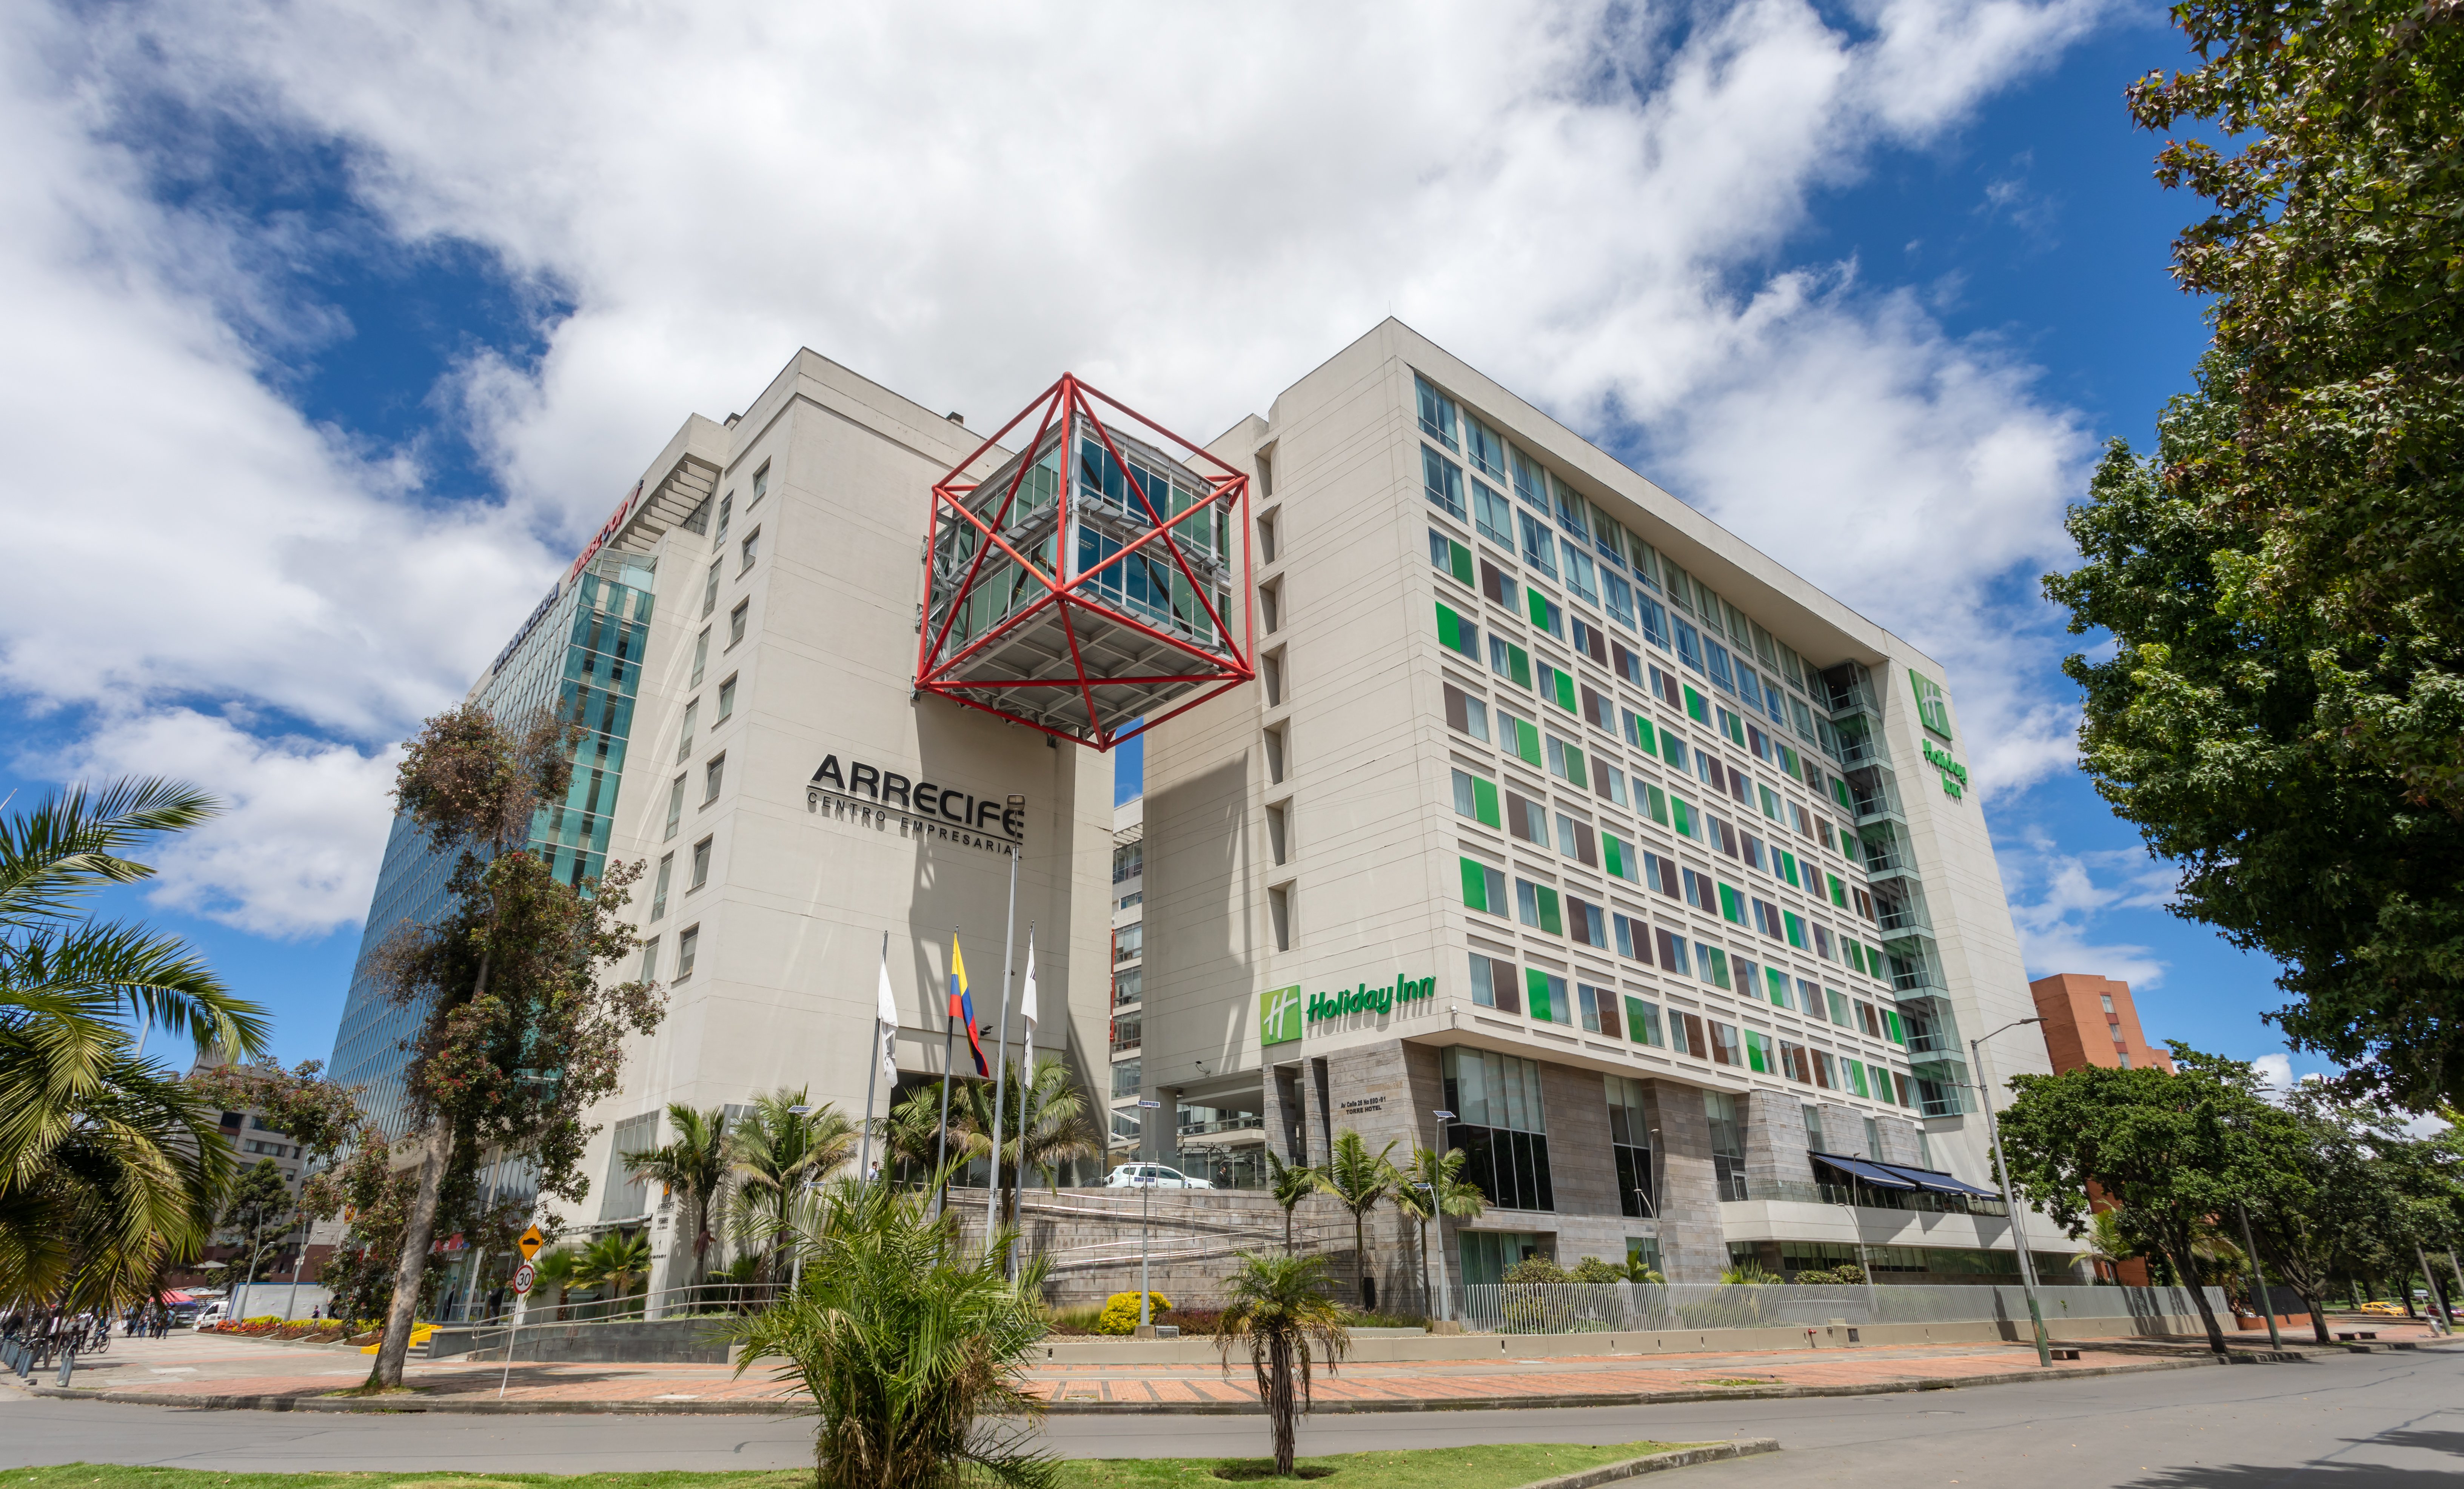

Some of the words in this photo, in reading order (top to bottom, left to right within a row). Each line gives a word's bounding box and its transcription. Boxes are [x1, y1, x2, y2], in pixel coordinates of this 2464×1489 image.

[492, 582, 559, 676] FINANCIERA
[1922, 738, 1967, 784] Holiday
[1940, 770, 1962, 799] Inn
[810, 754, 1025, 839] ARRECIFE
[807, 792, 886, 822] CENTRO
[900, 816, 1022, 859] EMPRESARIA
[1307, 983, 1394, 1022] Holiday
[1396, 973, 1435, 1003] Inn
[517, 1273, 531, 1286] 30
